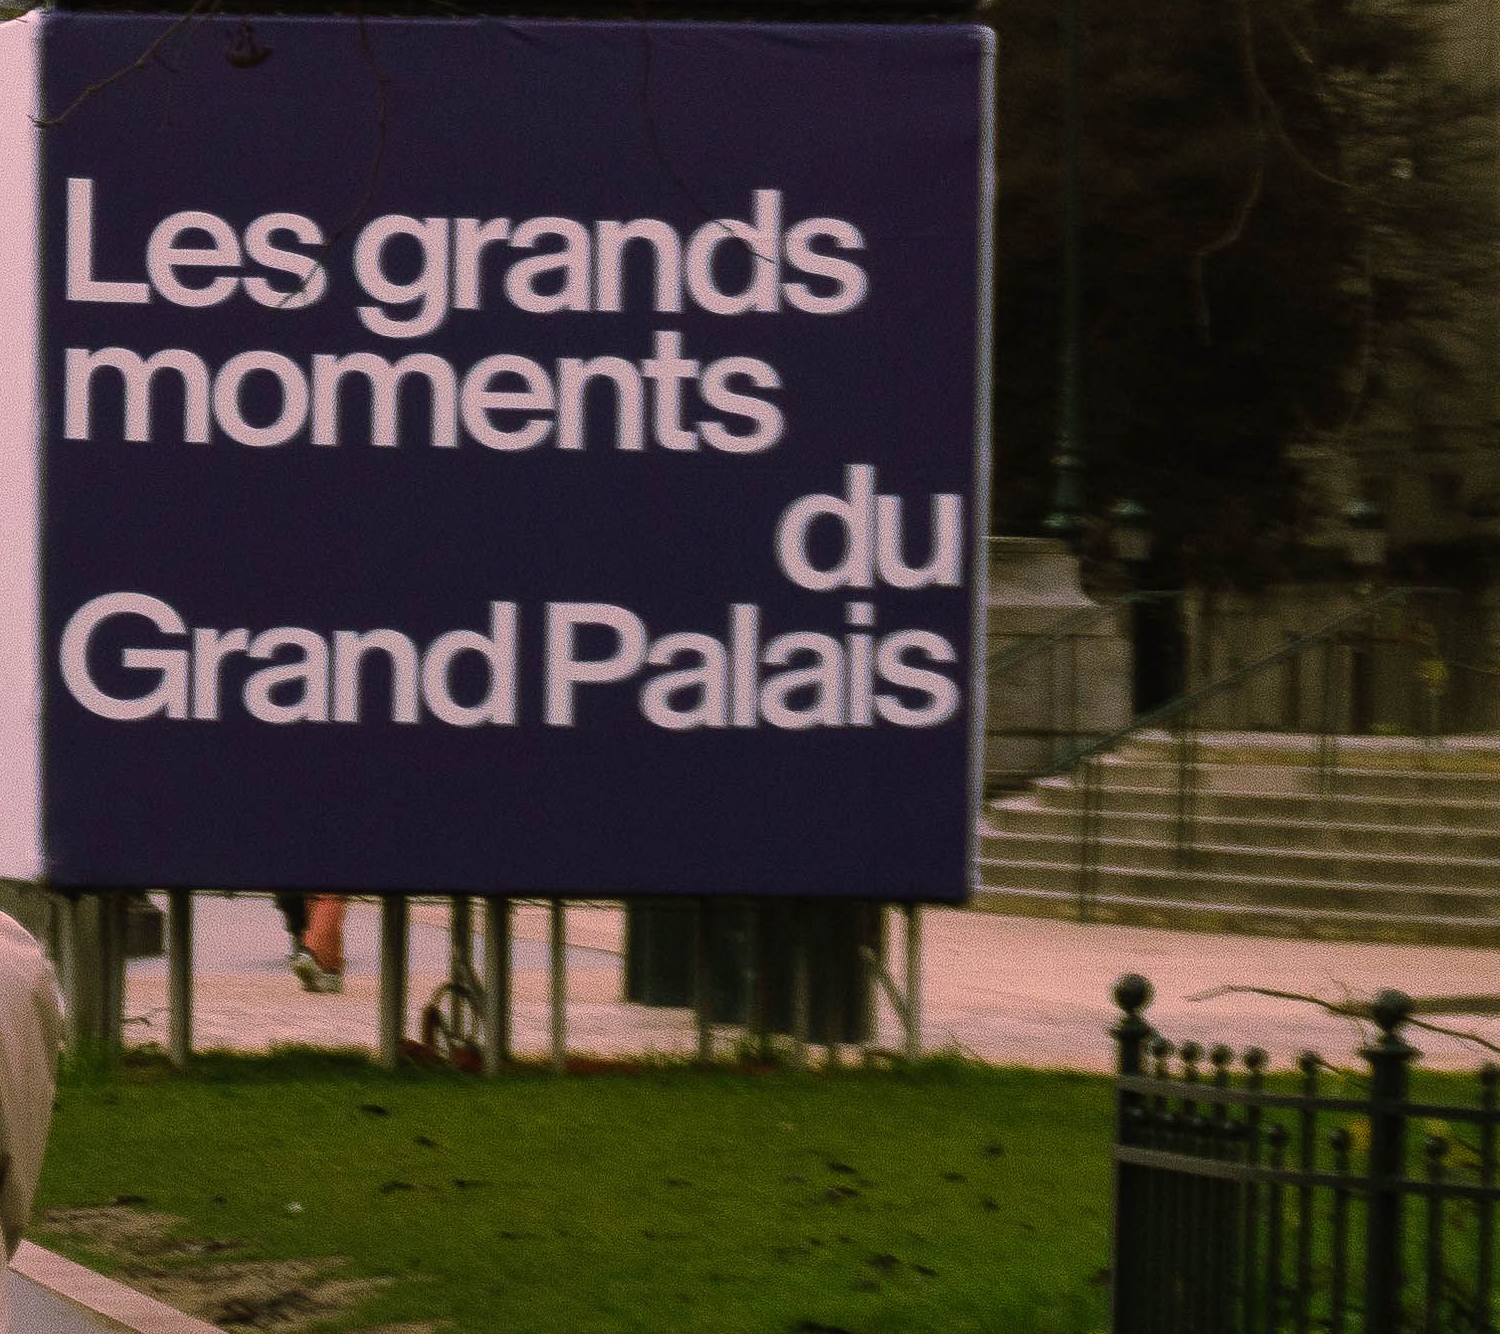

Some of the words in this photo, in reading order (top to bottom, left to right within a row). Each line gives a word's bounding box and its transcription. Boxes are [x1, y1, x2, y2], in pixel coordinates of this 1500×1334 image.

[66, 177, 328, 308] Les
[354, 189, 867, 339] grands
[64, 331, 785, 453] moments
[777, 463, 961, 592] du
[59, 590, 517, 728] Grand
[547, 599, 961, 731] Palais
